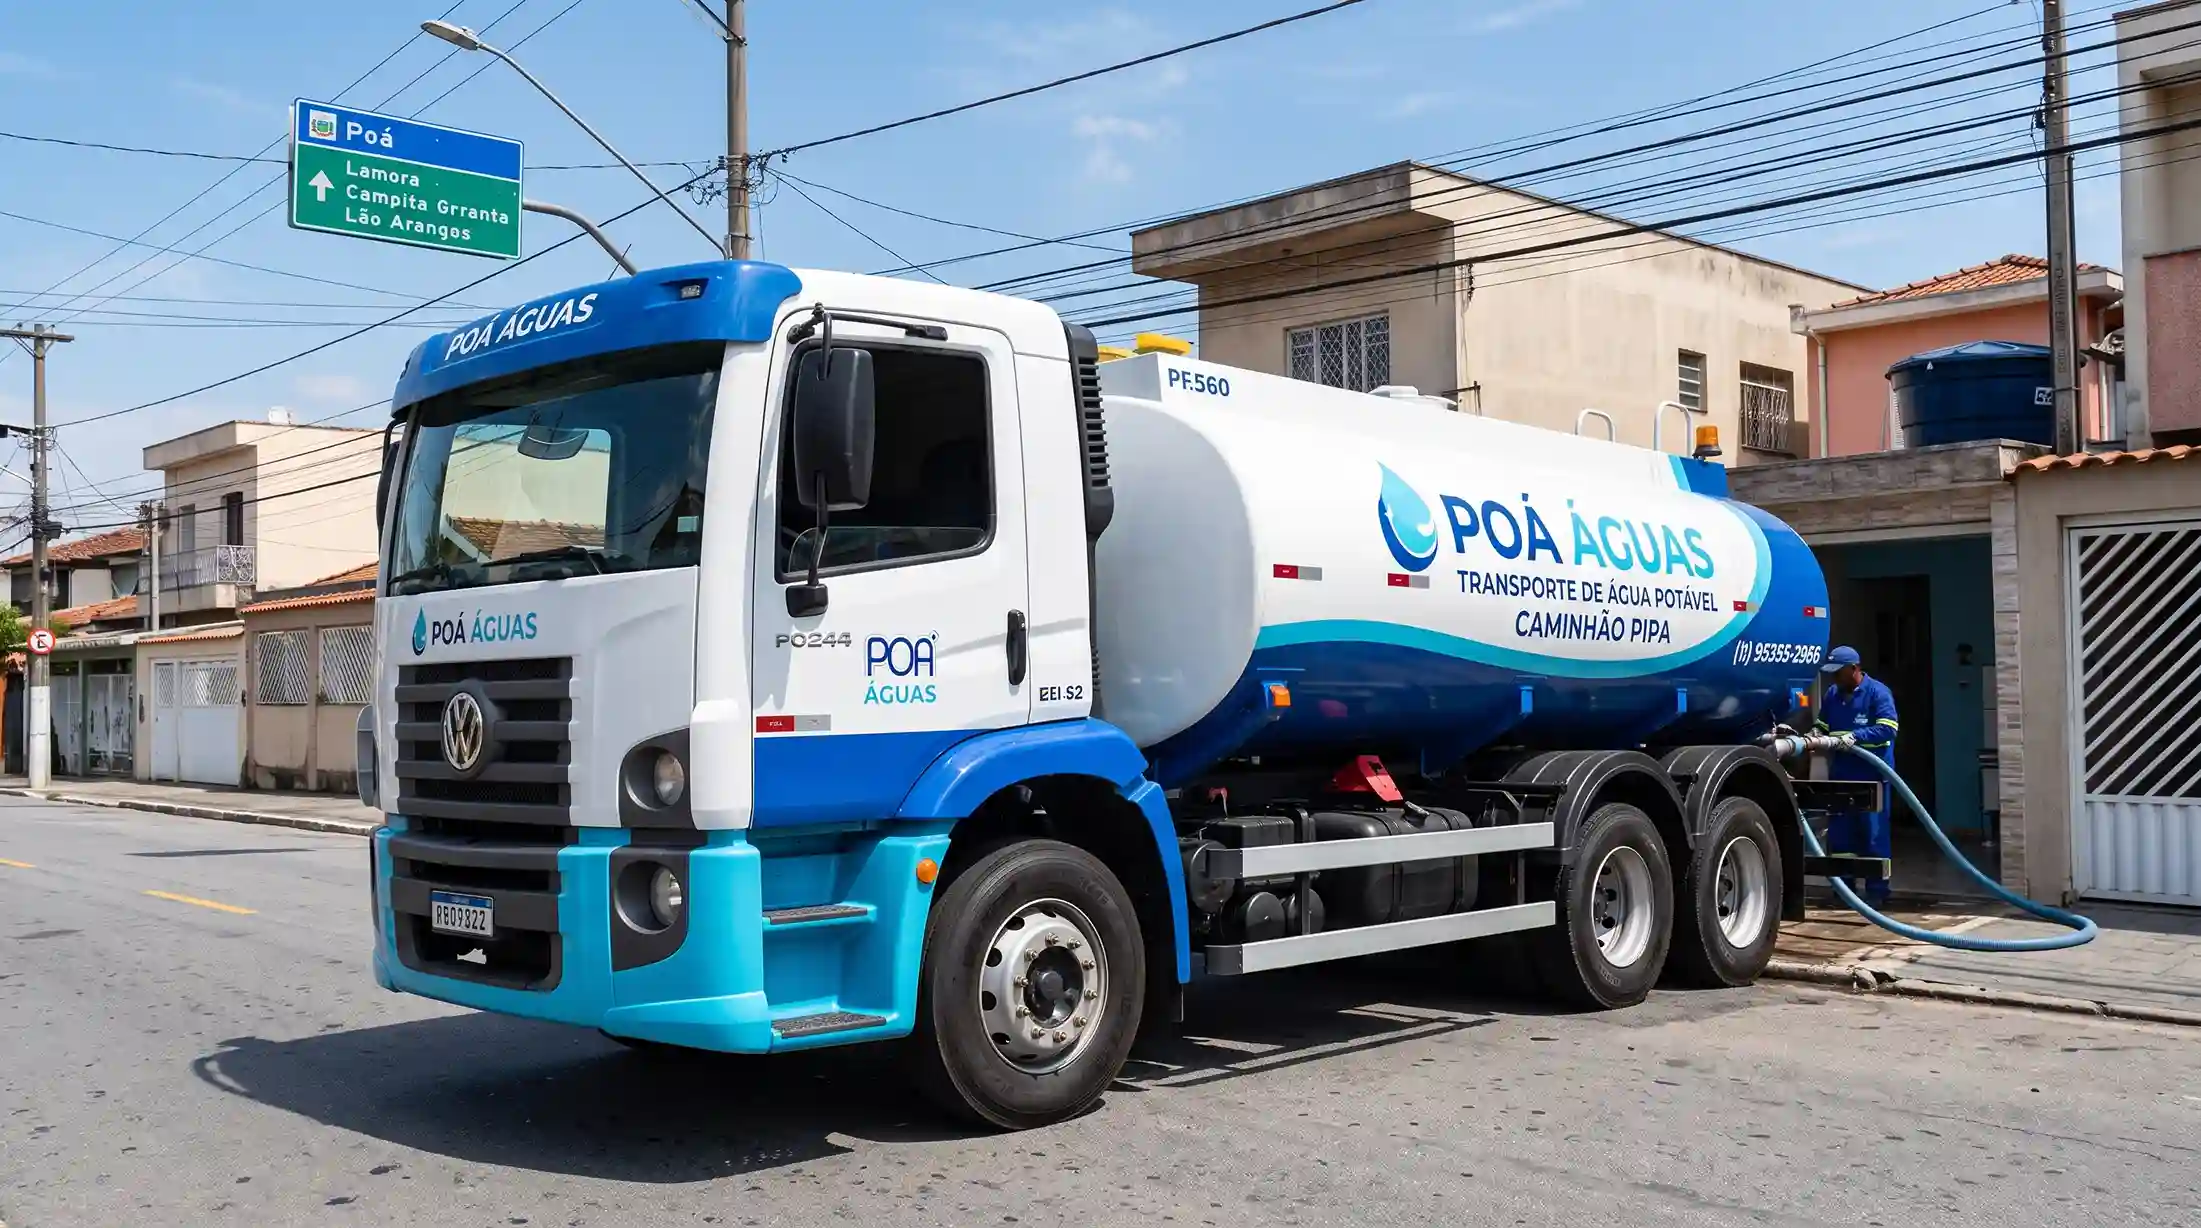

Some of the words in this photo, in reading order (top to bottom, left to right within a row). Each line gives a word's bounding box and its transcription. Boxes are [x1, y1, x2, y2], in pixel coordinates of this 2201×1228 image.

[346, 121, 393, 149] Poá
[346, 160, 420, 187] Lamora
[345, 207, 381, 226] Lão
[346, 185, 427, 211] Campita
[437, 200, 509, 225] Grranta
[444, 313, 500, 360] POÁ
[495, 293, 598, 343] ÁGUAS
[1439, 493, 1563, 565] POÁ
[1567, 499, 1715, 579] ÁGUAS
[1456, 570, 1576, 601] TRANSPORTE
[1582, 582, 1603, 604] DE
[1608, 578, 1651, 608] ÁGUA
[1654, 584, 1719, 612] POTÁVEL
[431, 612, 466, 646] POÁ
[471, 609, 538, 643] ÁGUAS
[1515, 608, 1626, 642] CAMINHÃO
[1629, 616, 1671, 645] PIPA
[864, 681, 937, 705] ÁGUAS
